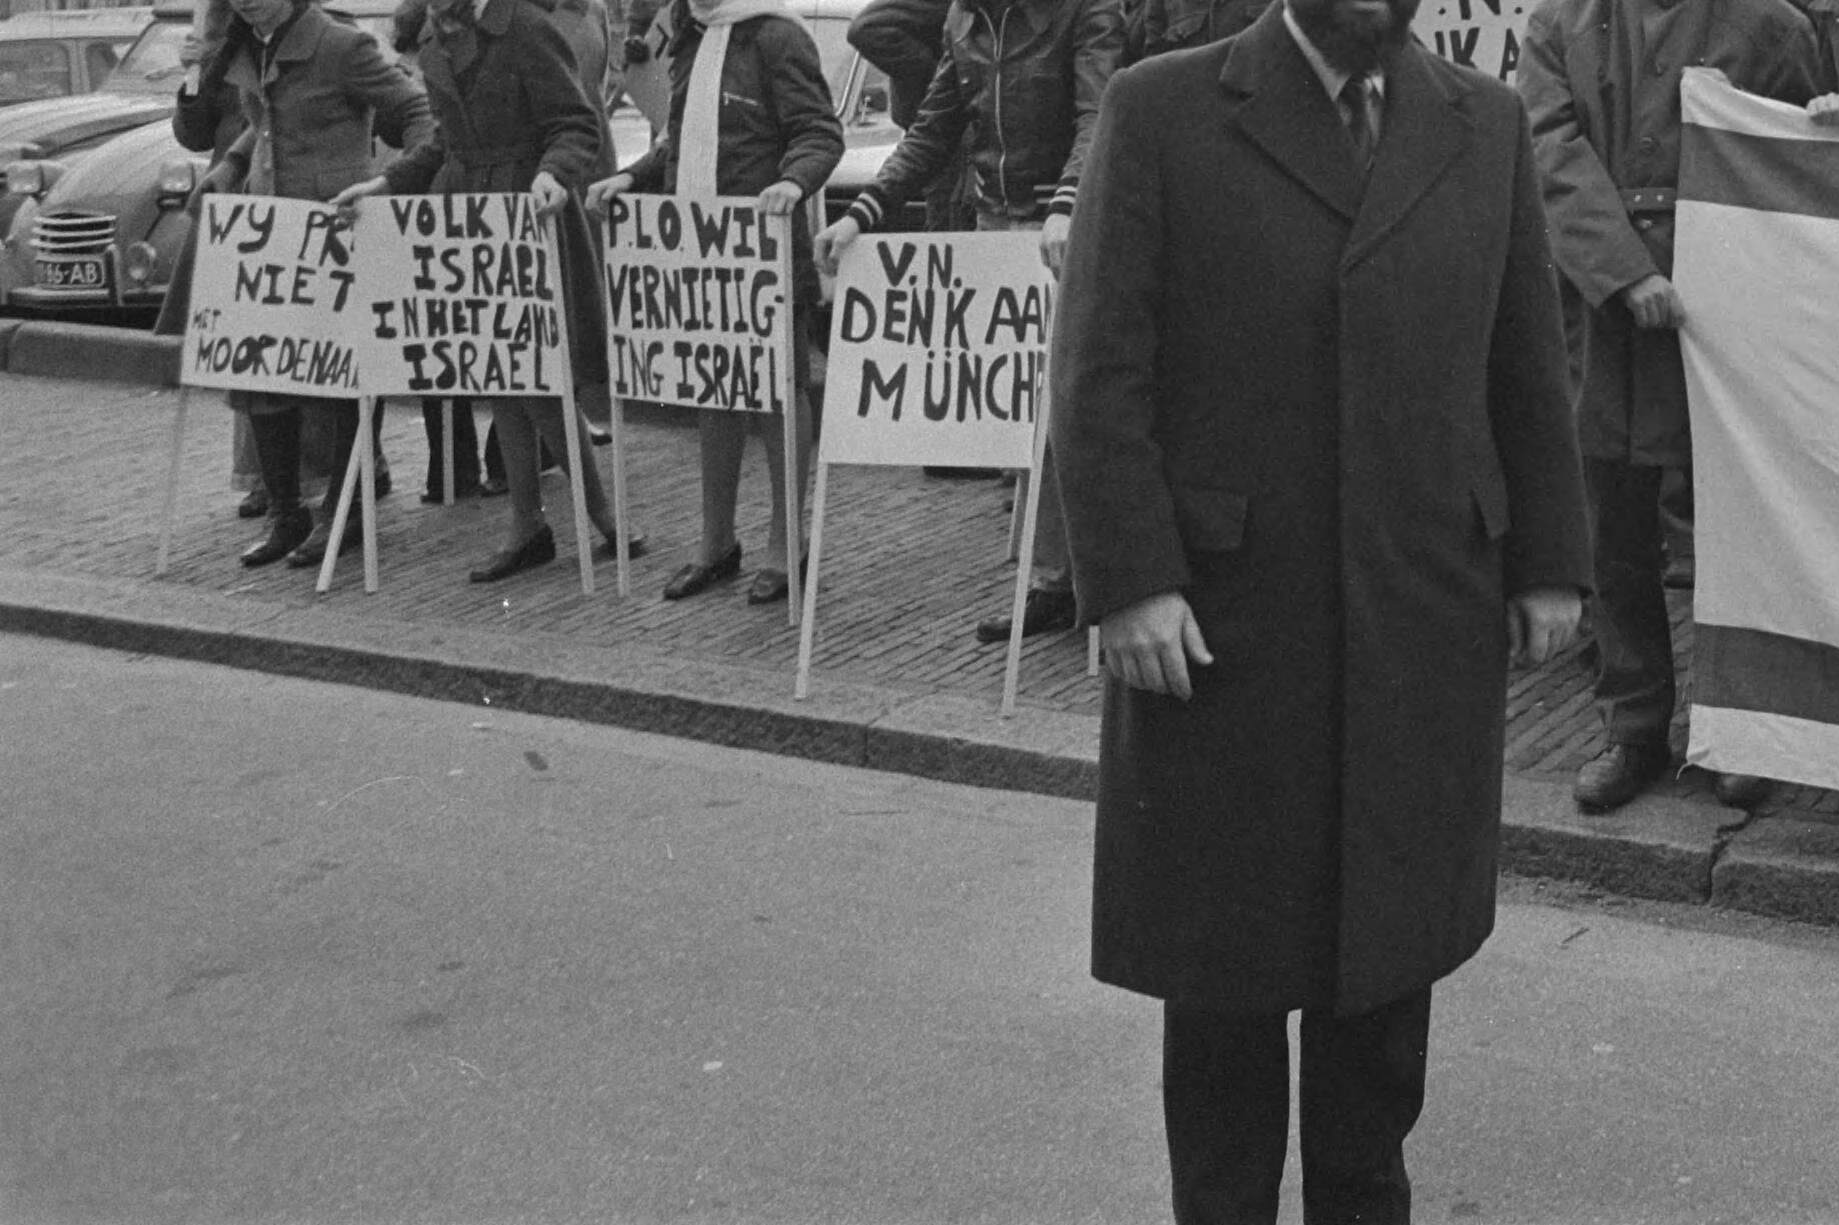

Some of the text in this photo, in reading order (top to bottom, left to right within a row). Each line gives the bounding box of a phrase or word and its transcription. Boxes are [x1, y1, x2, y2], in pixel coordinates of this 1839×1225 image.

[390, 194, 494, 239] VOLK
[690, 201, 778, 262] WIL
[235, 260, 355, 313] NIET
[413, 242, 554, 301] ISRAEL
[877, 241, 963, 289] V.N.
[425, 299, 490, 337] HET
[493, 302, 560, 349] LAND
[841, 286, 978, 351] DENK
[403, 339, 551, 393] ISRAEL
[613, 334, 665, 398] ING
